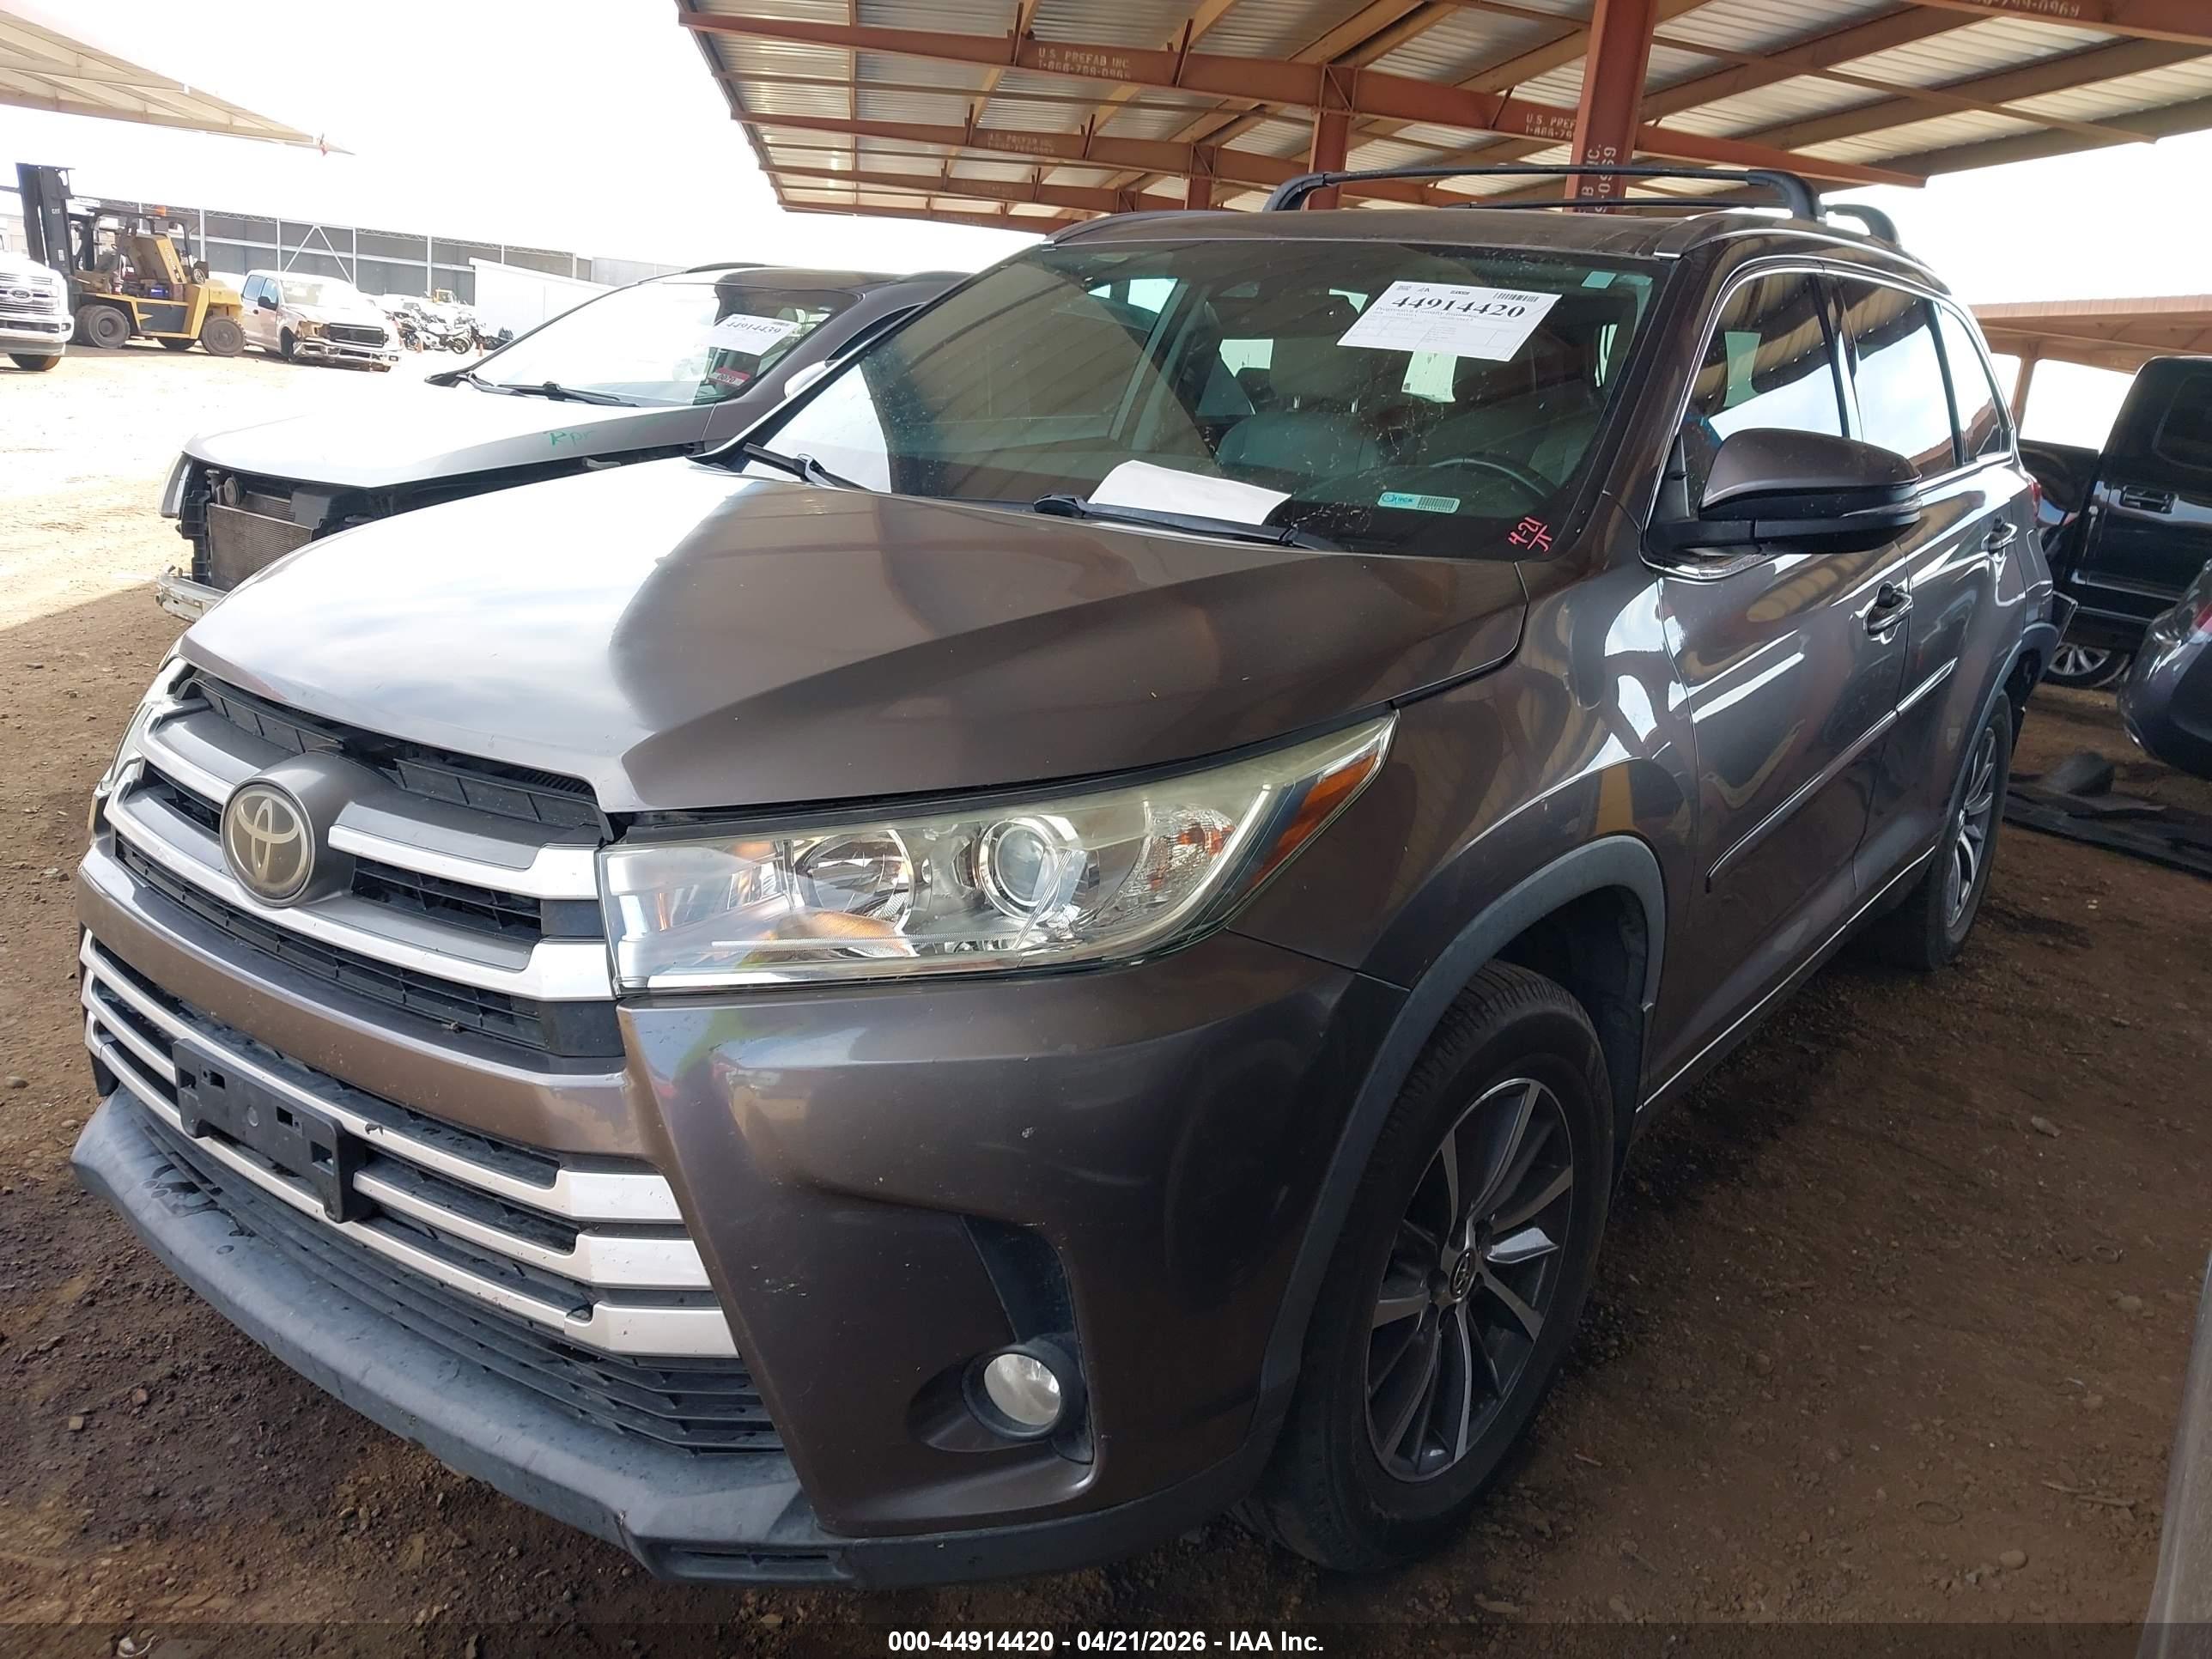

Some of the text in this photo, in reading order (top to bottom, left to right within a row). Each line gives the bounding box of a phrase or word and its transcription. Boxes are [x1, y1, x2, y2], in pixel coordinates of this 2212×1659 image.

[1065, 51, 1107, 66] PREFAB
[1550, 117, 1577, 130] PREF
[1392, 295, 1526, 318] 44914420
[1508, 517, 1542, 544] 4-21
